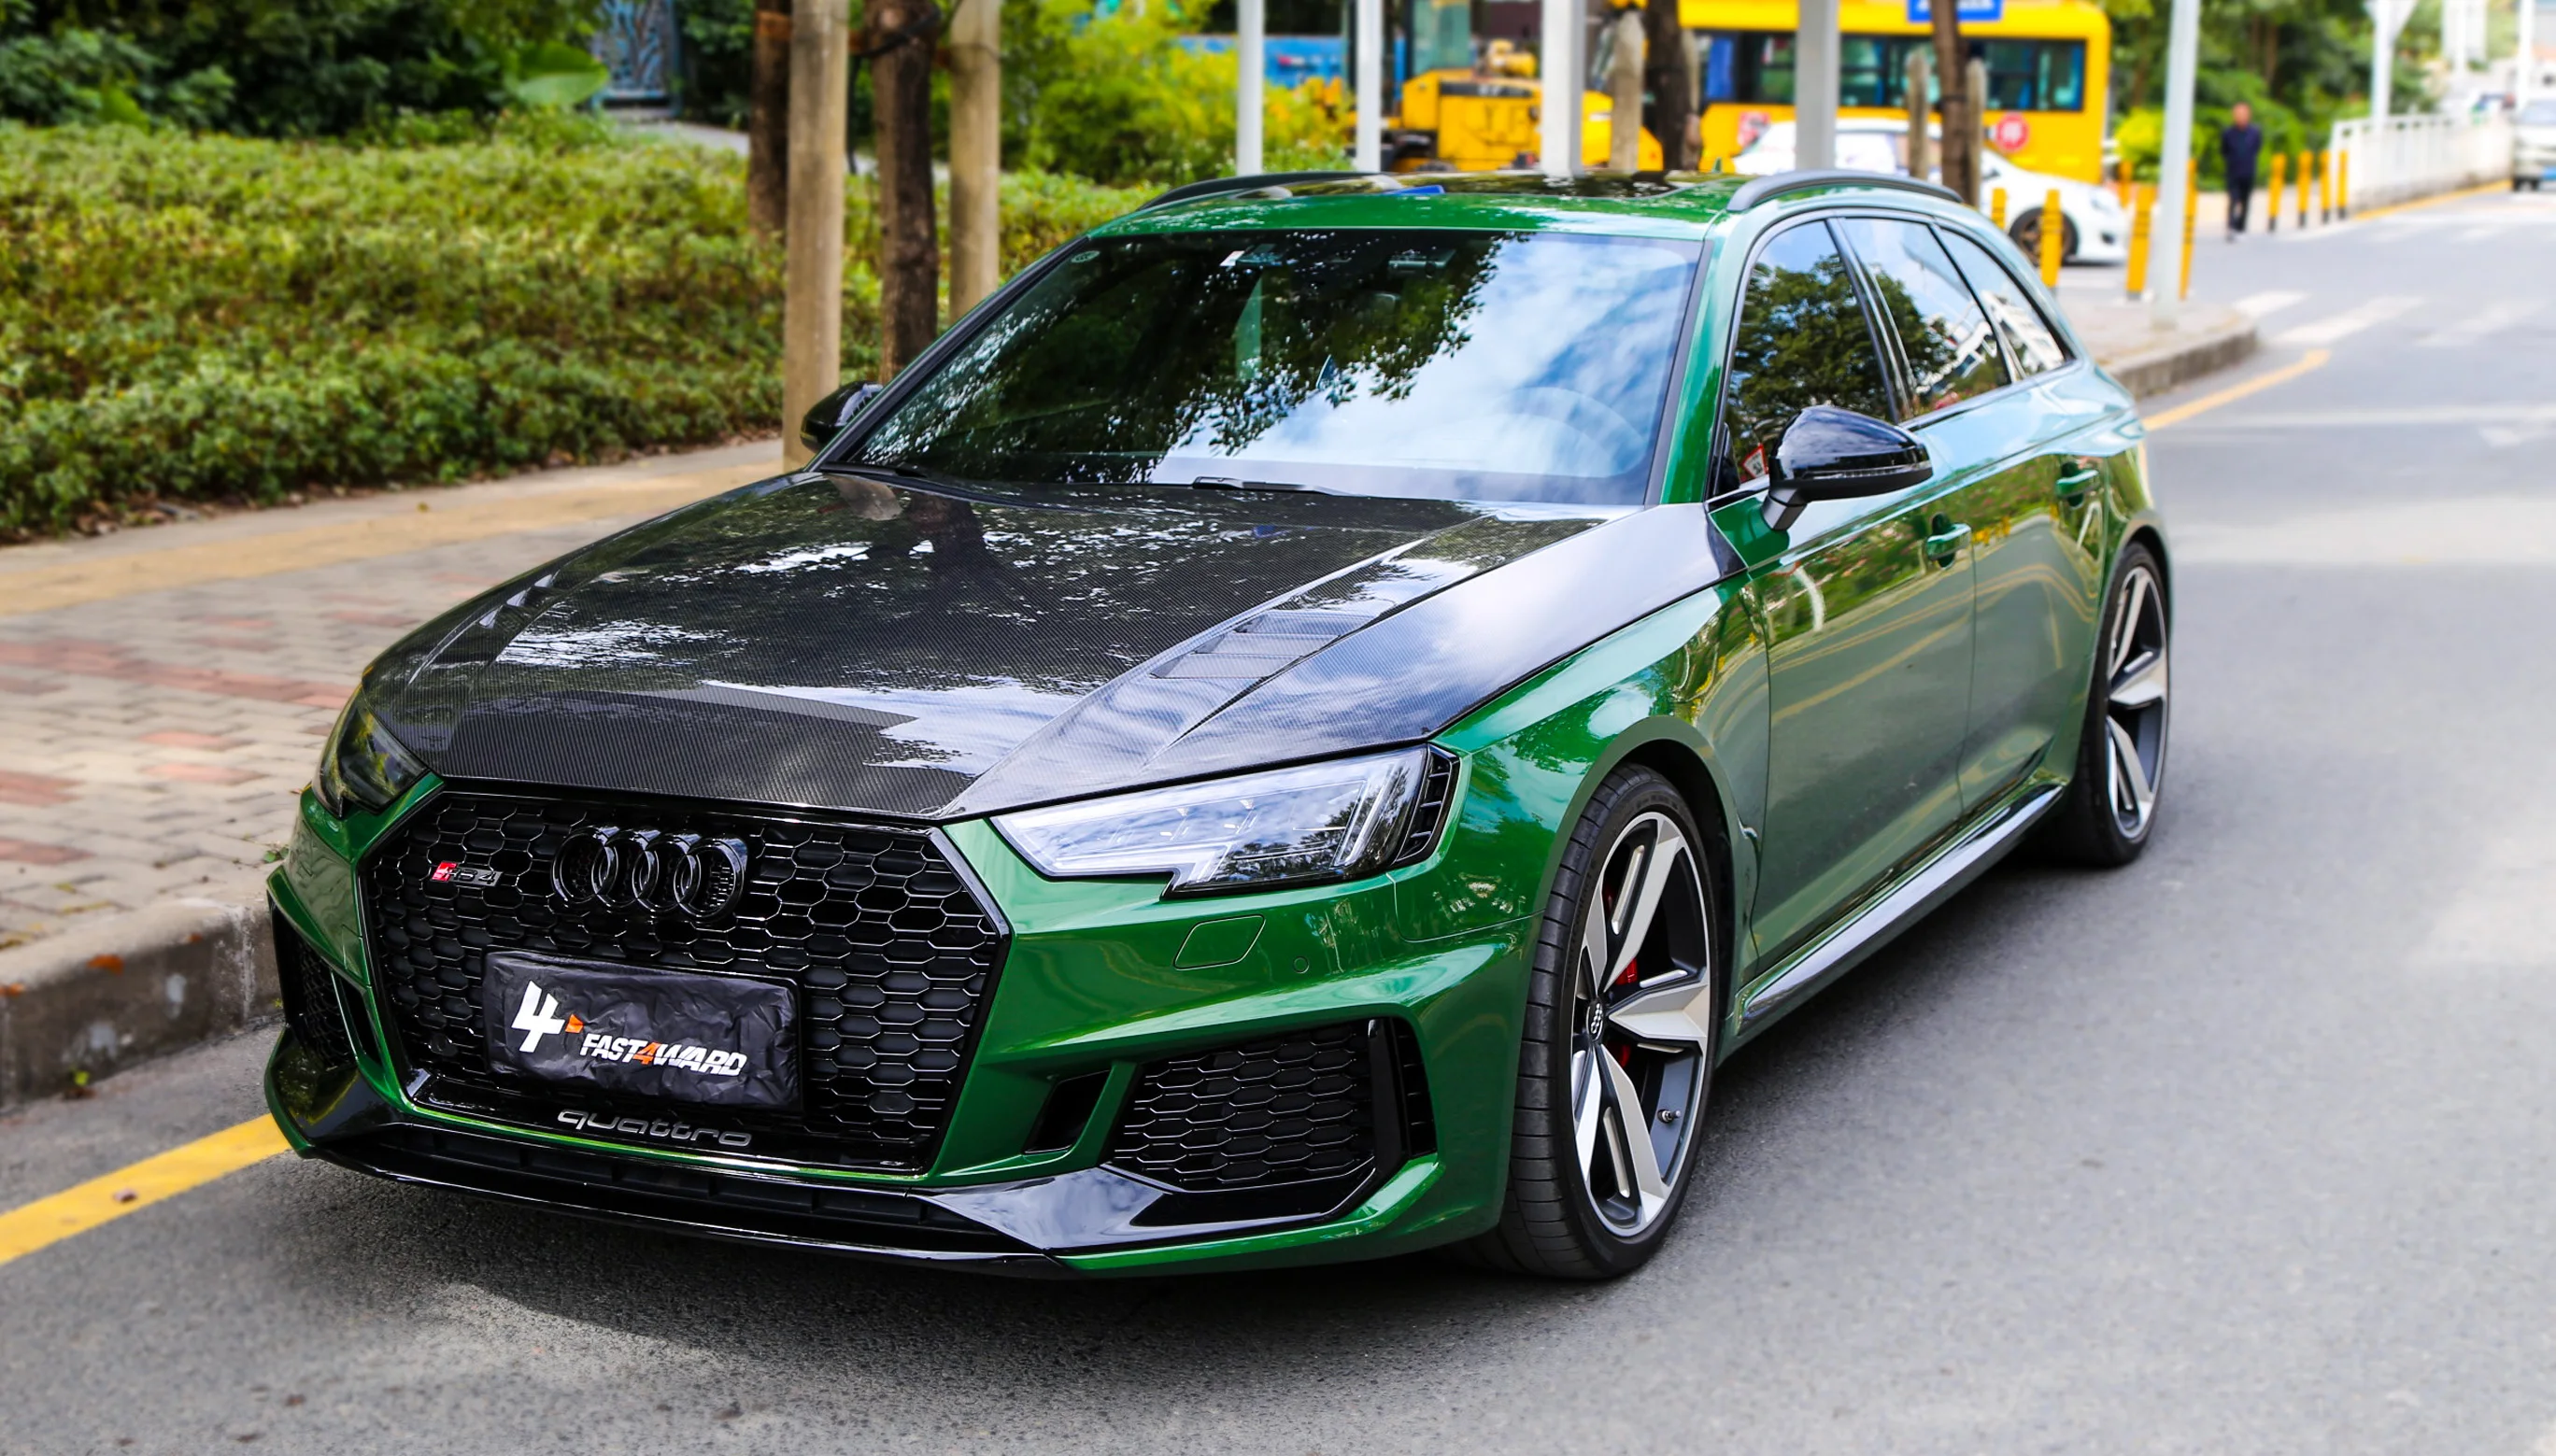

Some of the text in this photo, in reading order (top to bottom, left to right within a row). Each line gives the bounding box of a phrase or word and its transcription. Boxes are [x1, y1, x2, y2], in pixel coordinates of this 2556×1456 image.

[512, 981, 565, 1053] 4
[579, 1034, 747, 1076] FAST4WARD
[557, 1109, 752, 1147] quattro
